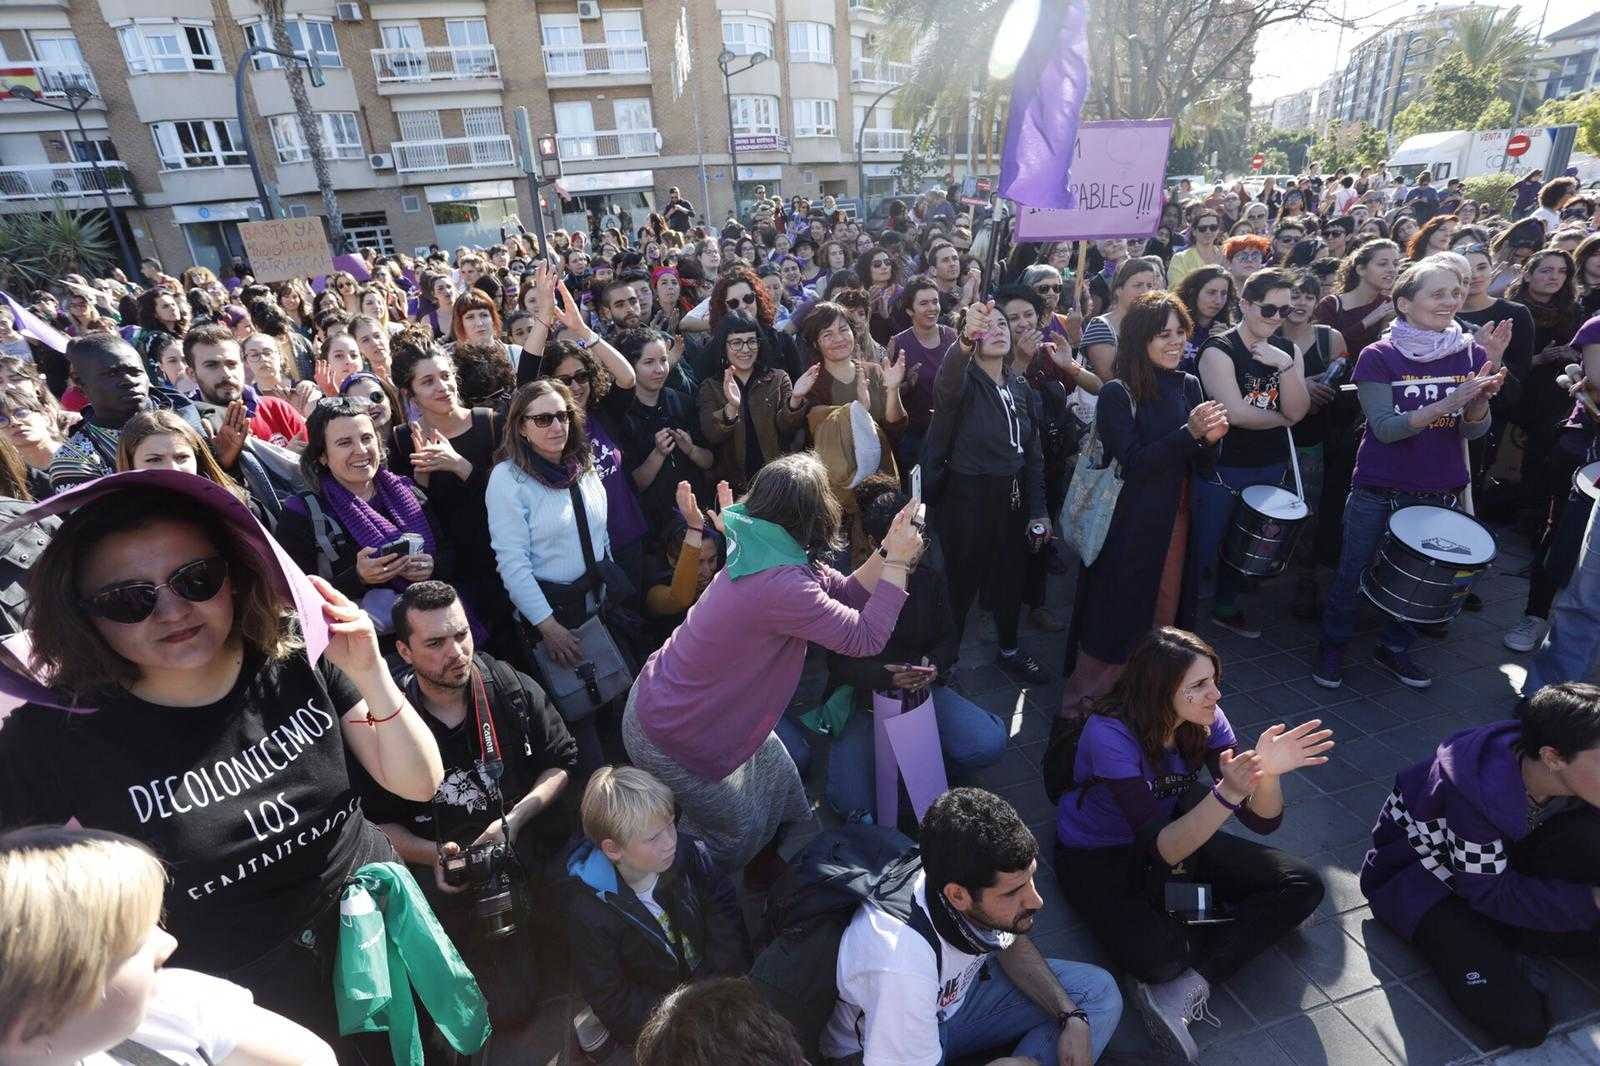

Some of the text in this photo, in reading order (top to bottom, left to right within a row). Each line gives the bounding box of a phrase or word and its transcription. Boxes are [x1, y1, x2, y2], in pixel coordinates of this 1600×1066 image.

[1480, 132, 1502, 142] VENTA
[482, 722, 494, 753] Canon
[128, 698, 333, 824] DECOLONICEMOS
[243, 791, 300, 842] LOS
